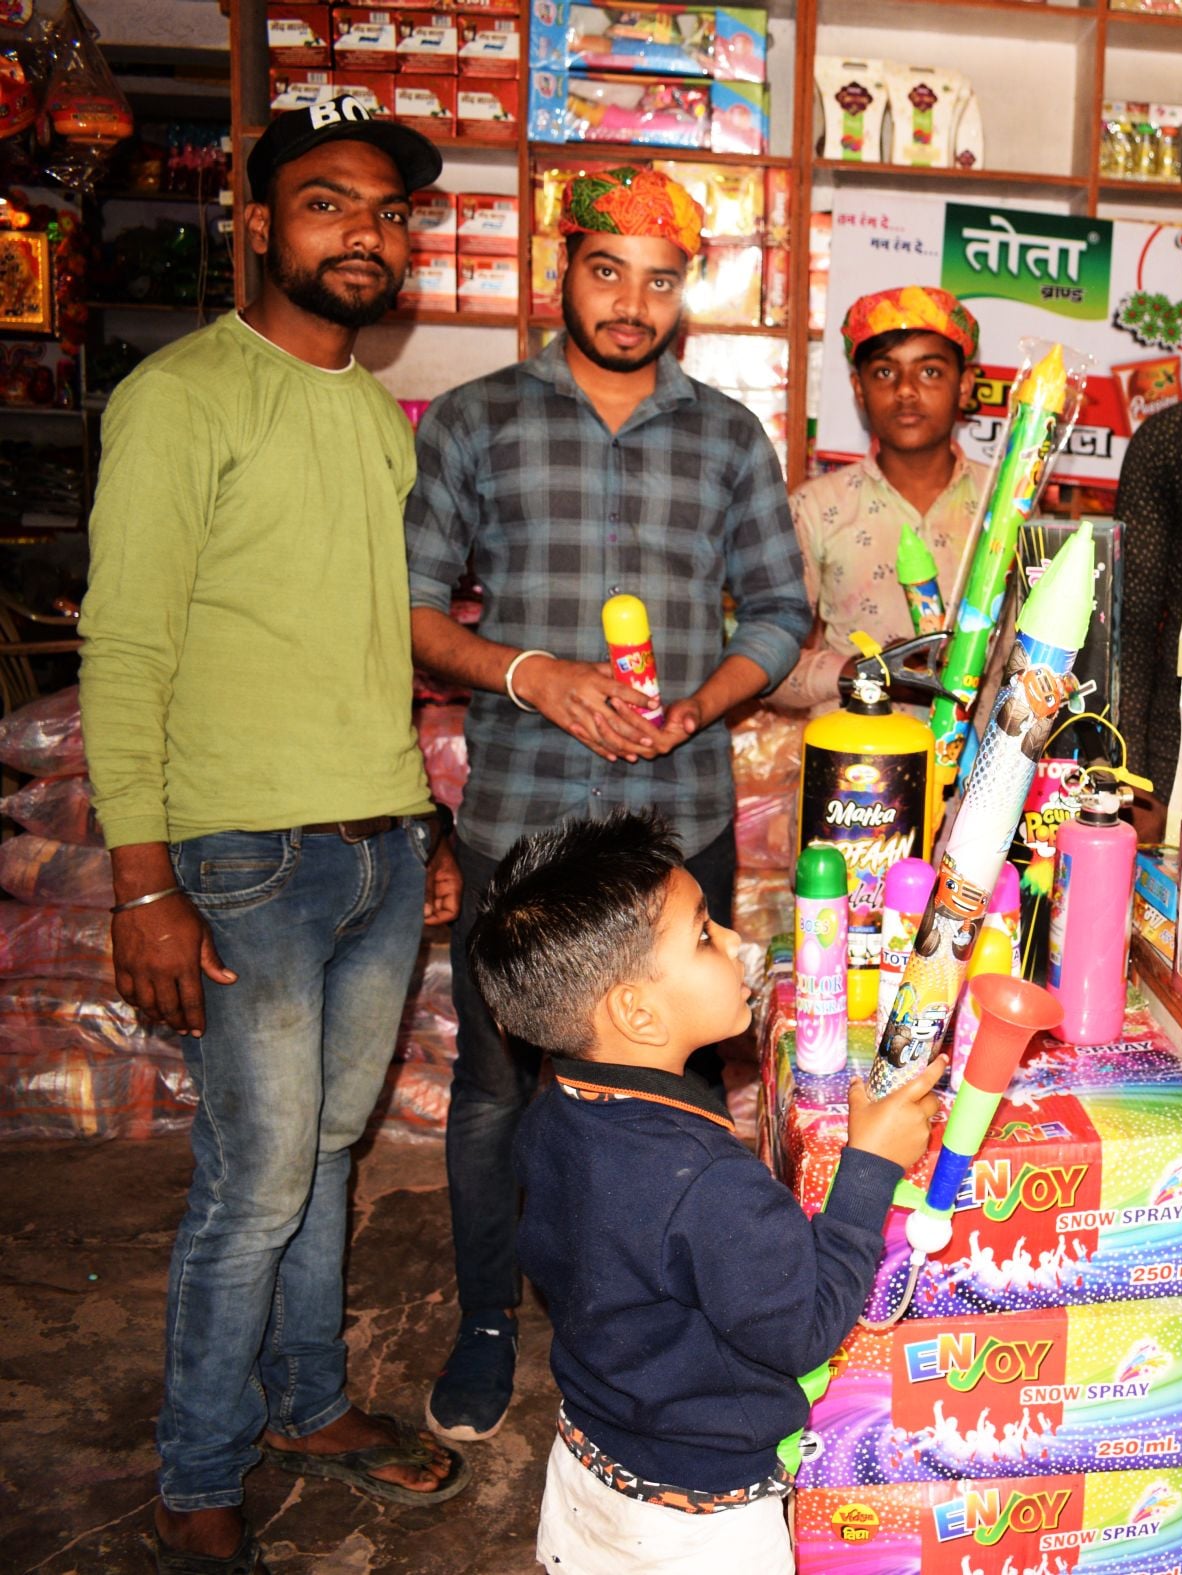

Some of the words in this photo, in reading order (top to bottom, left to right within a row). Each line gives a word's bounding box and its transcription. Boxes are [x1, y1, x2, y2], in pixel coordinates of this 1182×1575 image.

[962, 215, 1087, 282] तोता
[884, 951, 910, 966] TOT
[1076, 1041, 1152, 1056] SPRAY
[1057, 1210, 1115, 1232] SNOW
[1132, 1266, 1174, 1283] 250
[904, 1332, 1055, 1392] ENJOY
[1022, 1387, 1080, 1404] SNOW
[1087, 1382, 1150, 1400] SPRAY
[1098, 1440, 1139, 1458] 250
[934, 1487, 1074, 1547] ENJOY
[1041, 1529, 1096, 1550] SNOW
[1102, 1522, 1161, 1541] SPRAY
